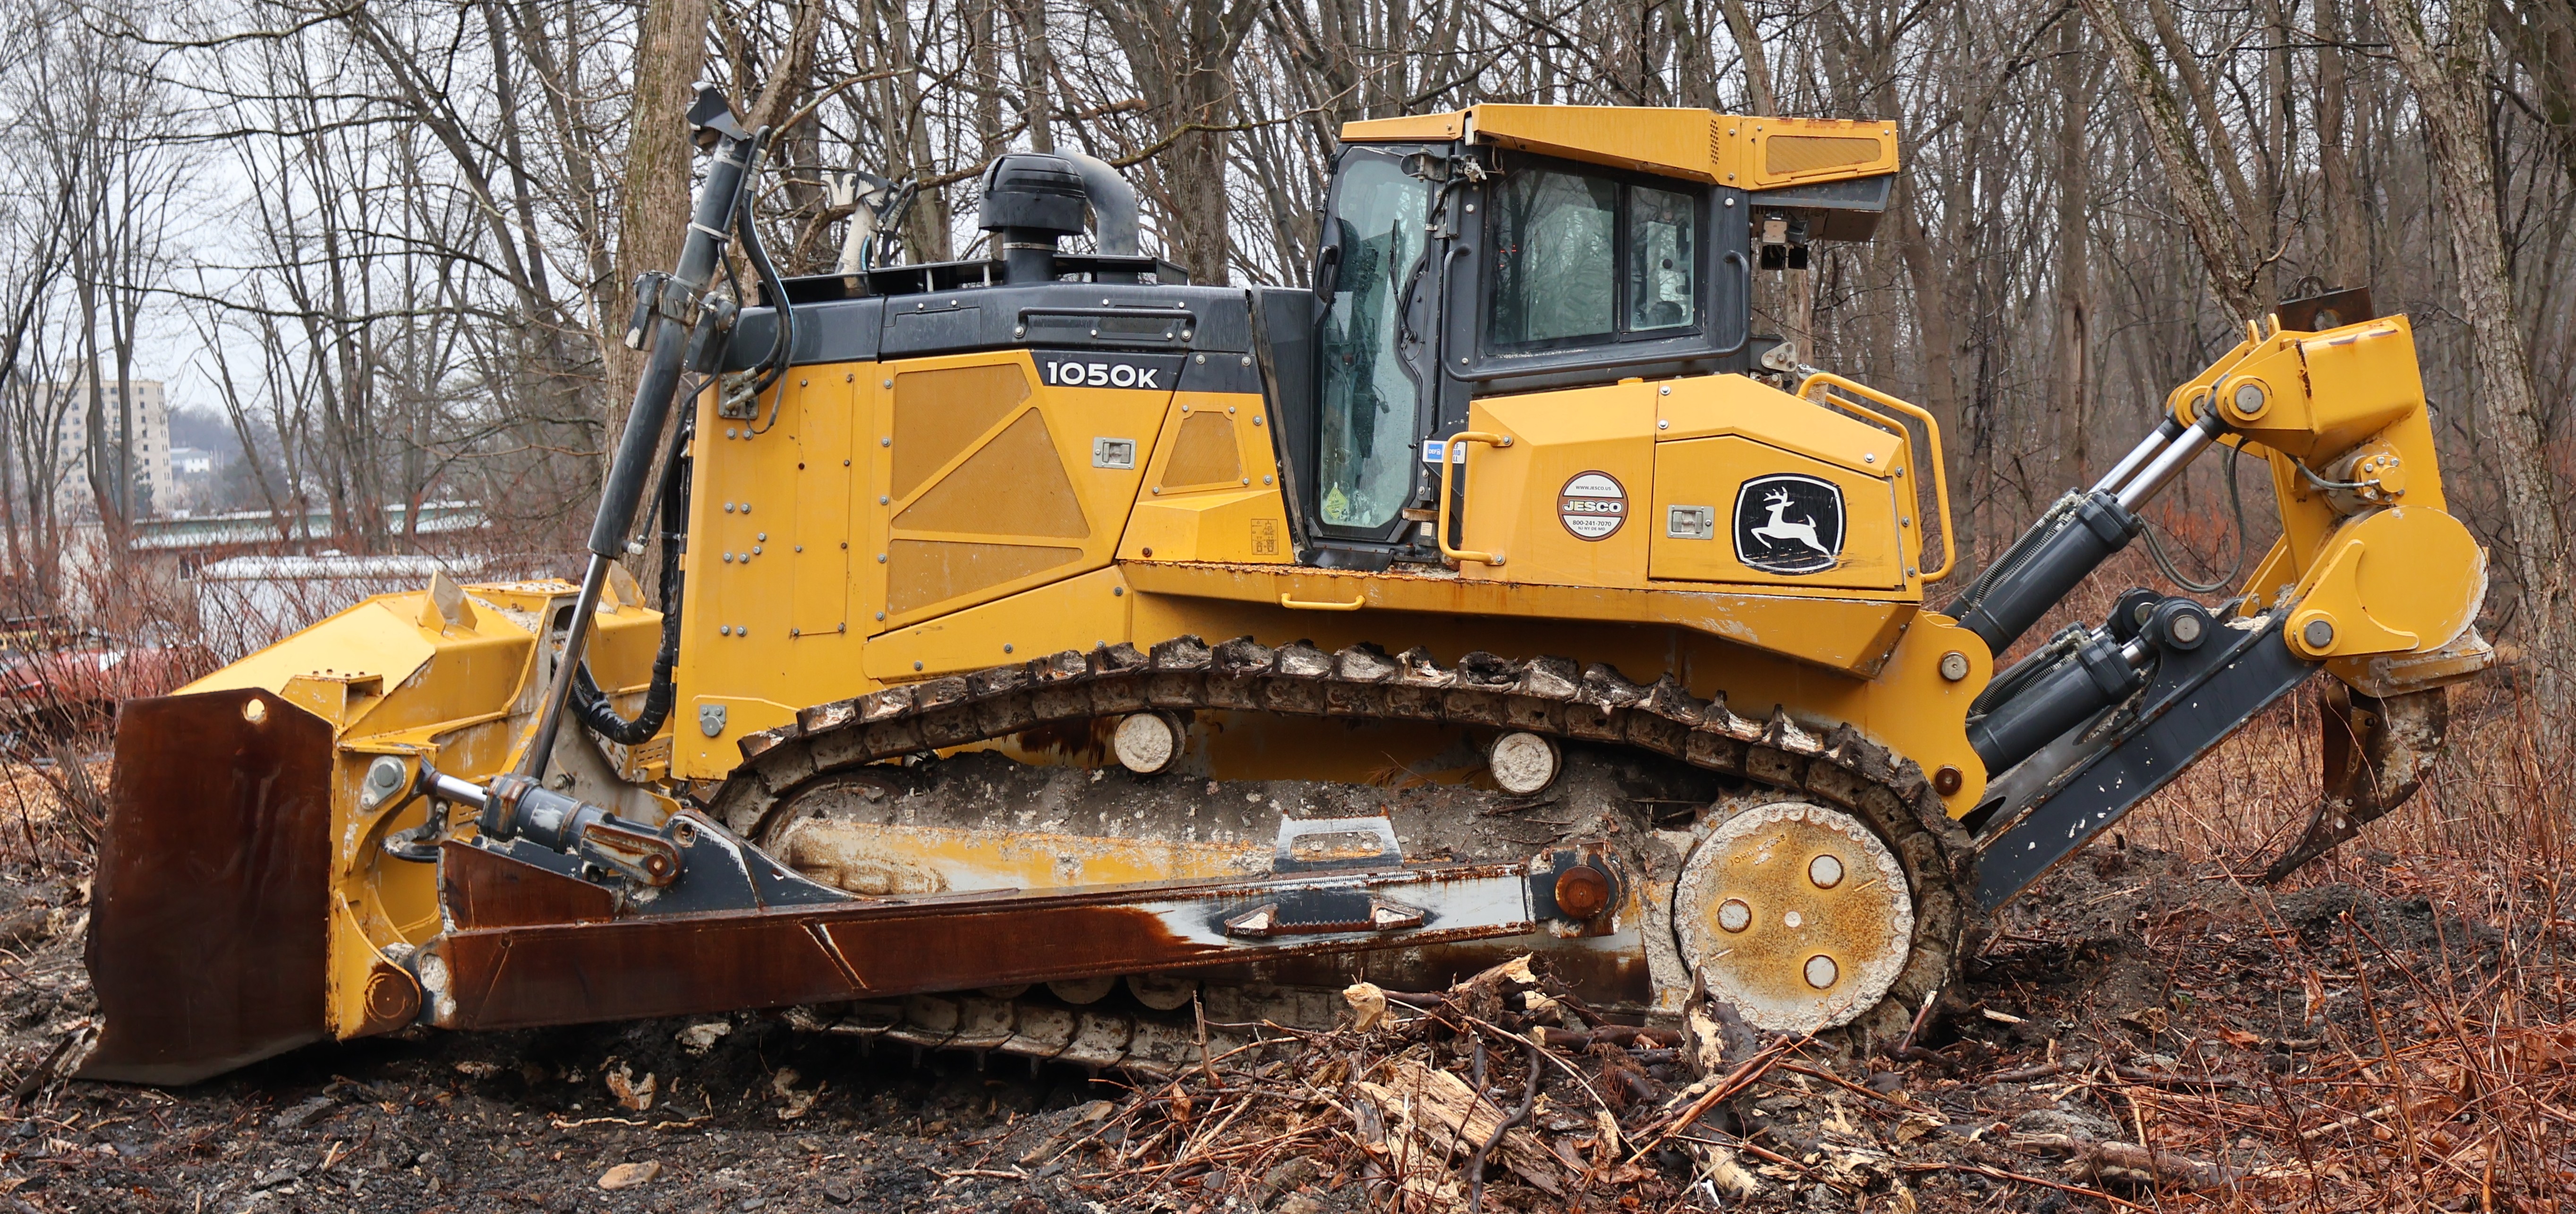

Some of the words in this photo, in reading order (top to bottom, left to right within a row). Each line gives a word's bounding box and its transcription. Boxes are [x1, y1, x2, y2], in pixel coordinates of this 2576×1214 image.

[1047, 362, 1158, 388] 1050K
[1563, 500, 1623, 514] JESCO
[1730, 849, 1754, 866] JOHN
